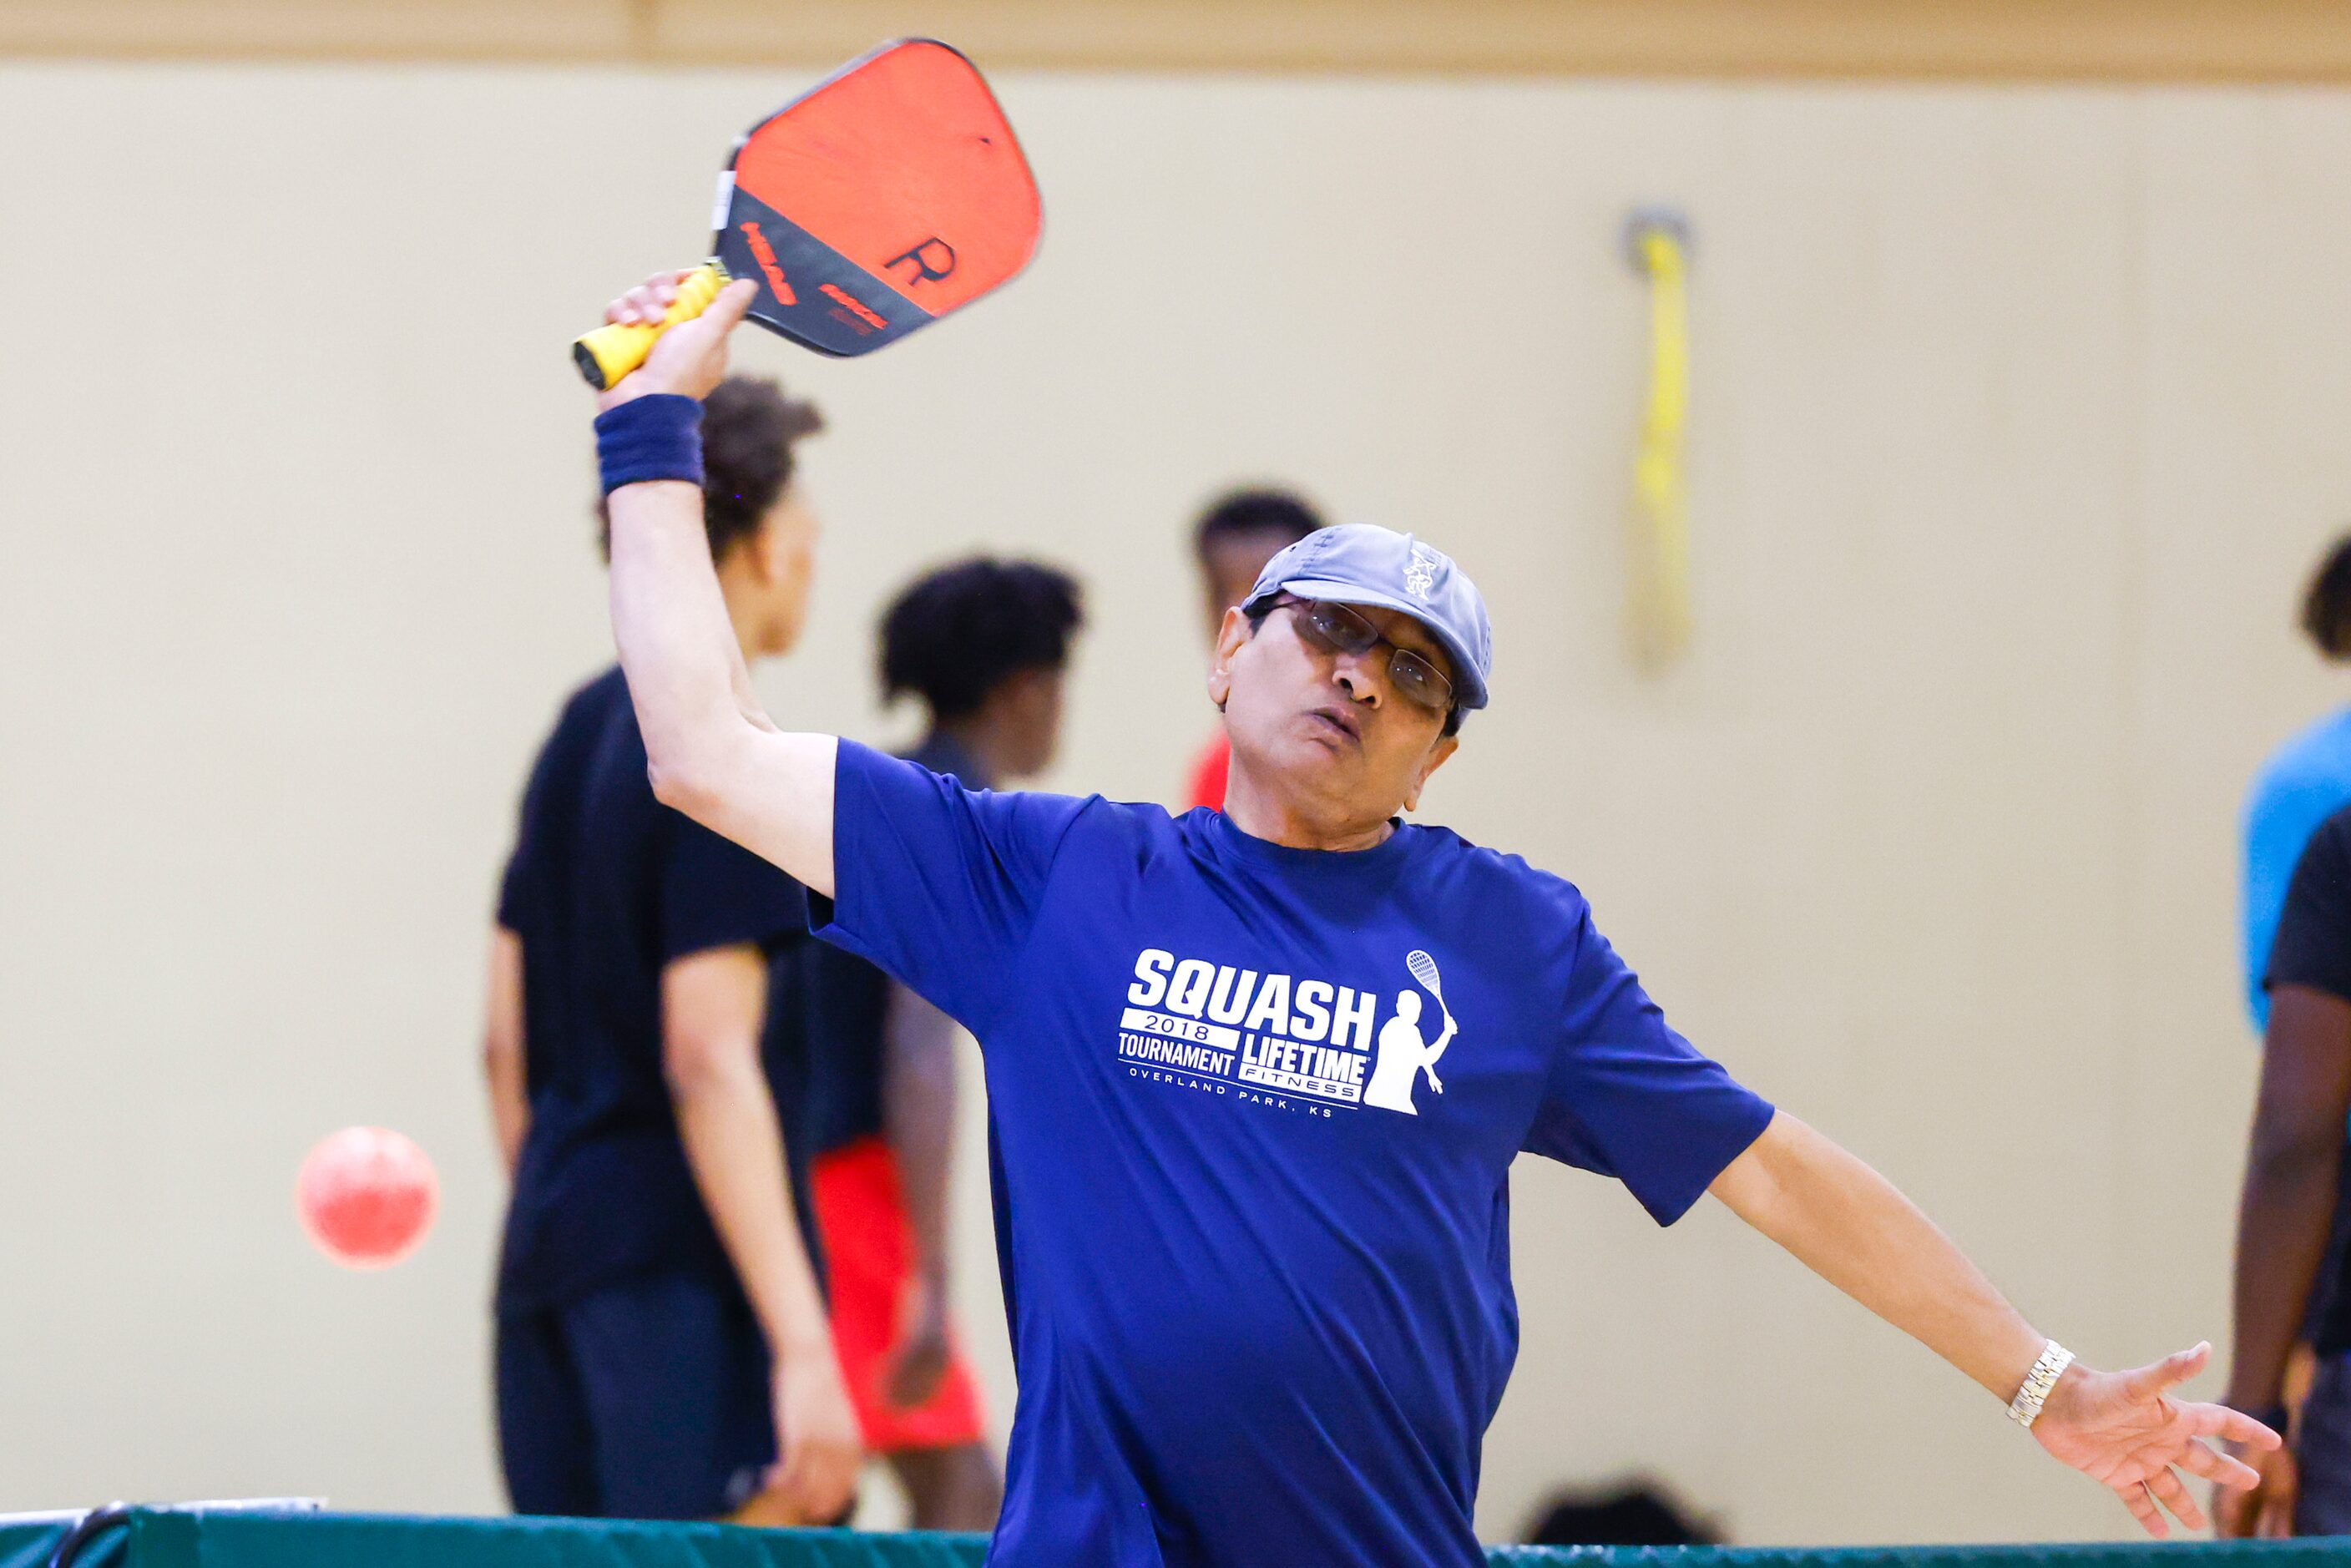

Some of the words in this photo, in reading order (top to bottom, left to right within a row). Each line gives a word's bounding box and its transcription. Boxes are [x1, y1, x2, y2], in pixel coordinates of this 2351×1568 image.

[1127, 948, 1377, 1050] SQUASH
[1144, 1014, 1209, 1041] 2018
[1118, 1032, 1235, 1076] TOURNAMENT
[1241, 1034, 1367, 1085] LIFETIME
[1129, 1068, 1226, 1095] OVERLAND
[1238, 1091, 1296, 1111] PARK,
[1309, 1105, 1332, 1118] KS
[1245, 1068, 1356, 1098] FITNESS
